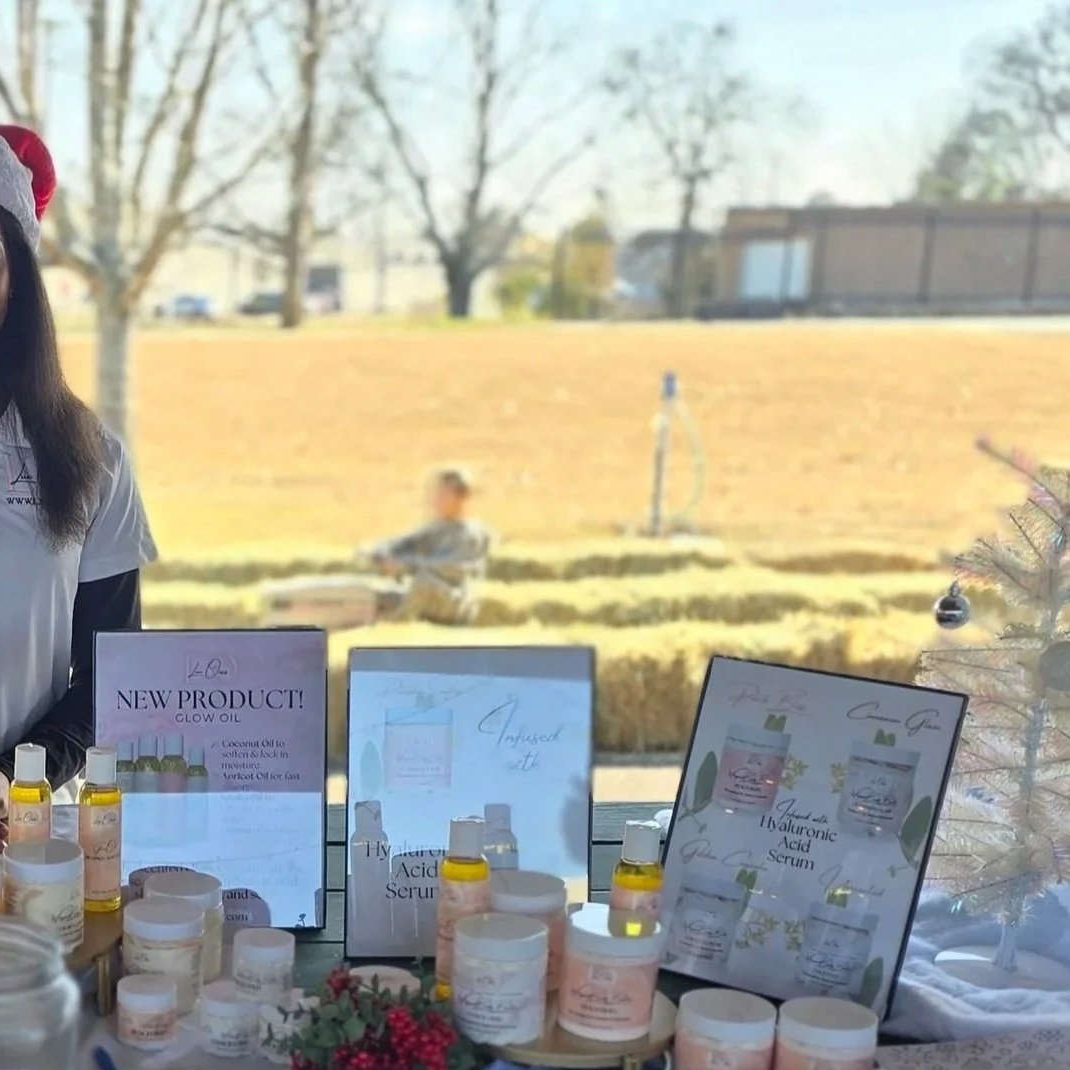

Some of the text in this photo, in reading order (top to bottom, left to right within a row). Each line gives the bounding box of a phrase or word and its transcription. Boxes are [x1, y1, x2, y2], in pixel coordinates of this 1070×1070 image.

[117, 689, 303, 710] NEW PRODUCT!
[175, 712, 241, 724] GLOW OIL
[221, 739, 260, 749] Coconut
[261, 738, 275, 748] Oil
[221, 750, 249, 759] soften
[221, 761, 261, 770] moisture
[759, 814, 838, 842] Hyaluronic
[777, 836, 811, 853] Acid
[766, 849, 815, 870] Serum
[395, 859, 439, 878] Acid
